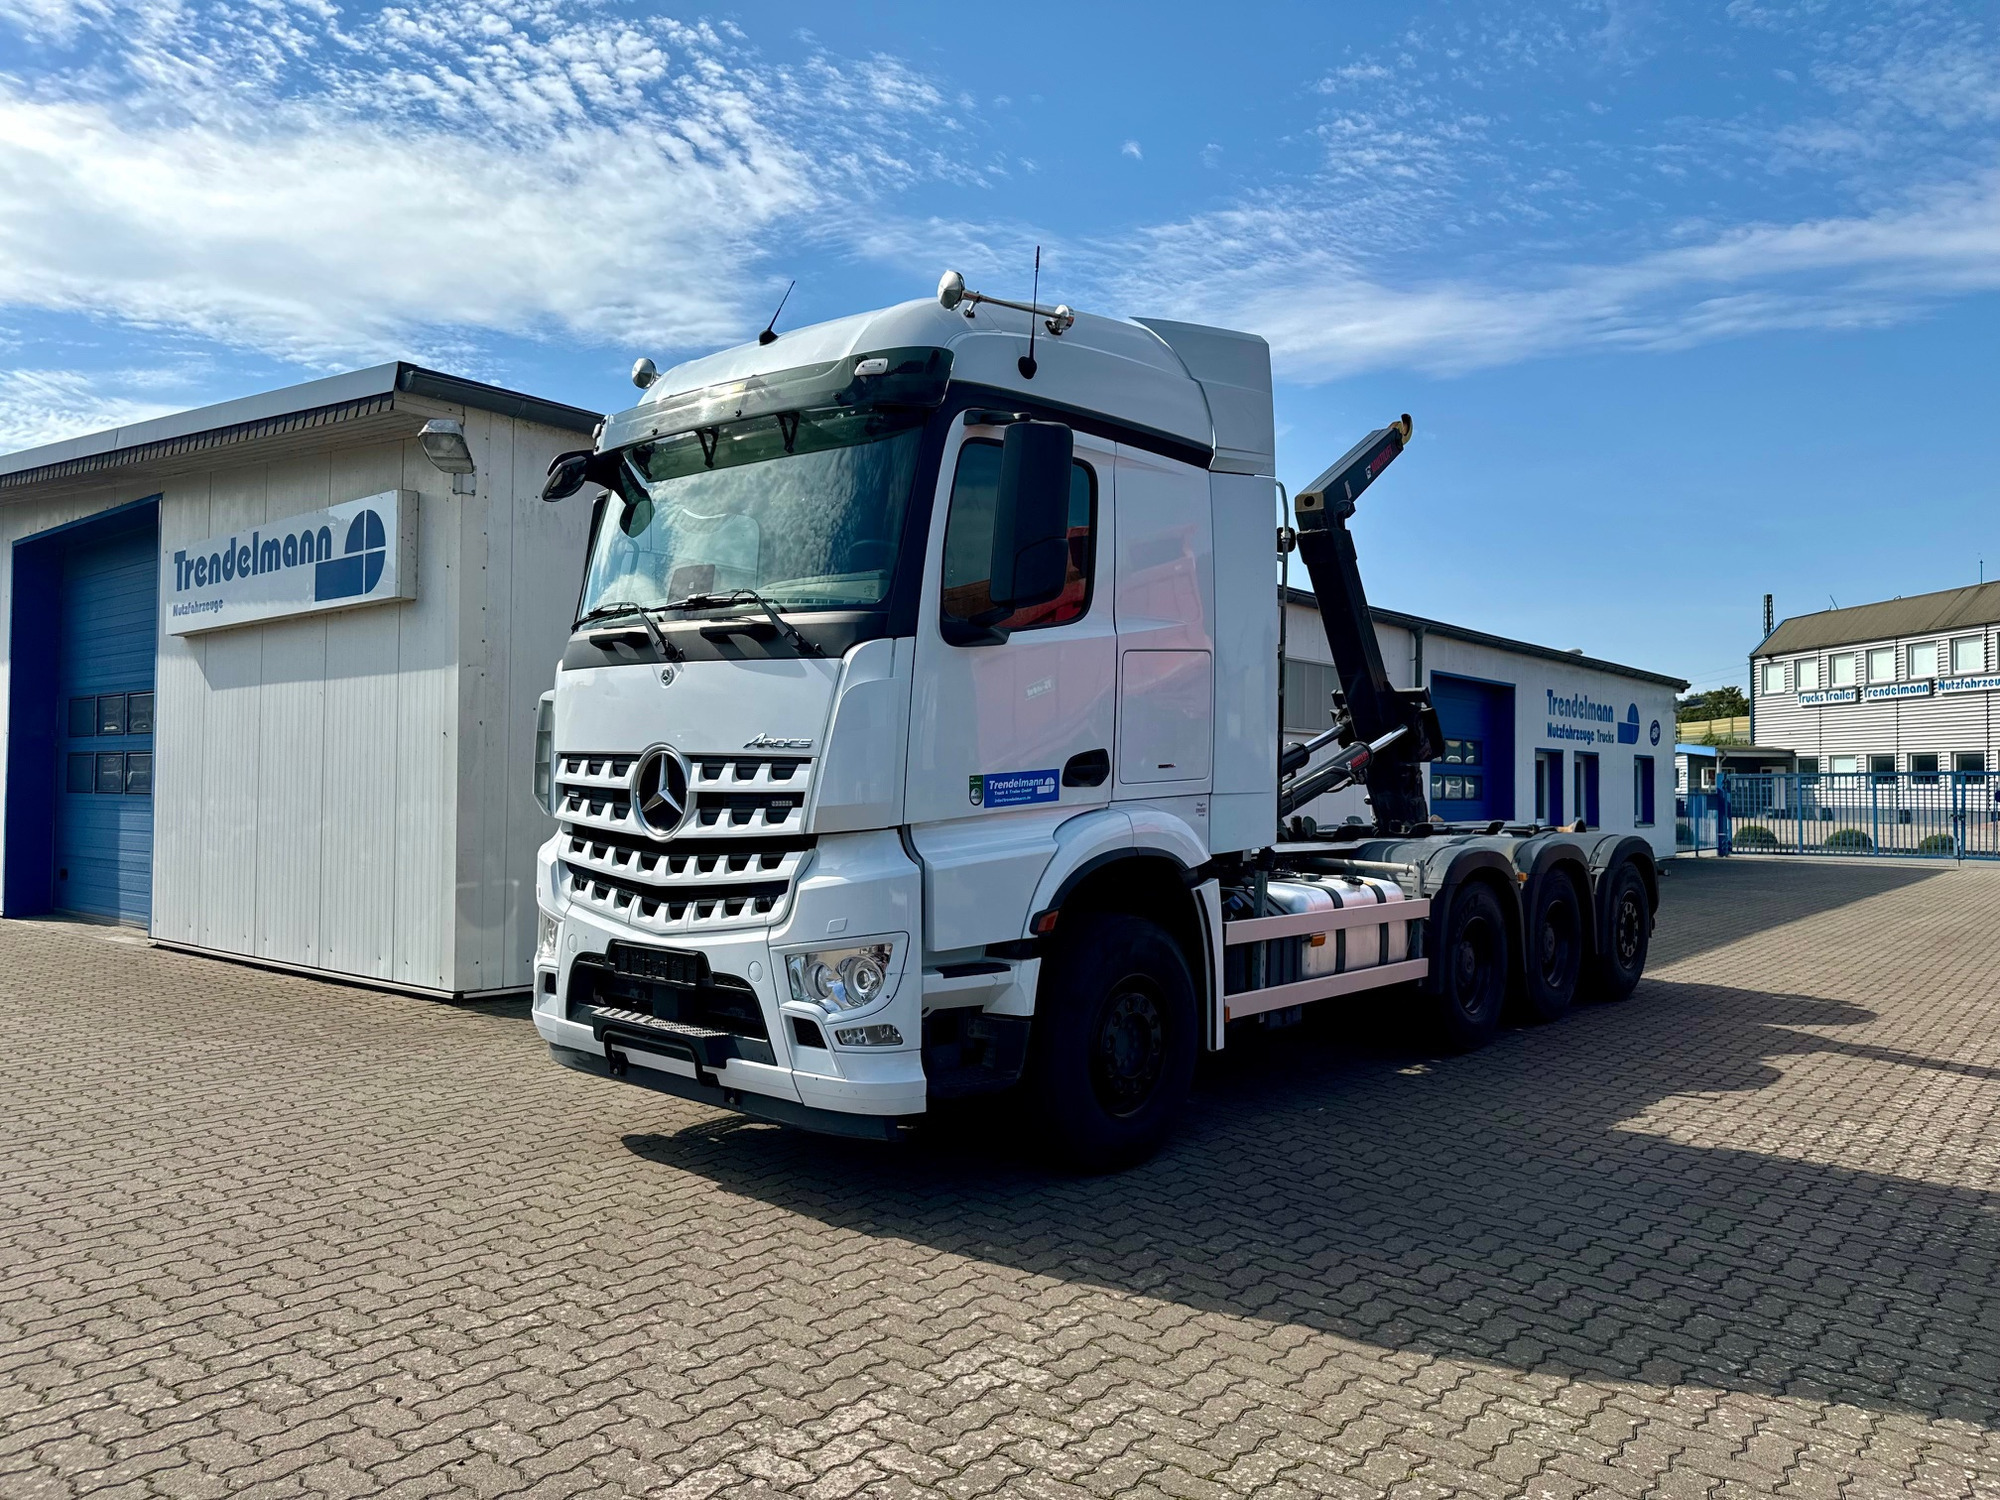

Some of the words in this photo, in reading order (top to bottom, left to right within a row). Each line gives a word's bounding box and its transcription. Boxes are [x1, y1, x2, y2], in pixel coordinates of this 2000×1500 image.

[174, 525, 332, 592] Trendelmann
[172, 598, 224, 617] Nutzfahrzeuge
[1798, 692, 1824, 704] Trucks
[1824, 688, 1855, 702] Trailer
[1864, 683, 1929, 698] Trendelmann
[1546, 688, 1614, 723] Trendelmann
[1546, 721, 1595, 746] Nutzfahrzeuge
[1596, 728, 1615, 744] Trucks
[989, 777, 1044, 790] Trendelmann
